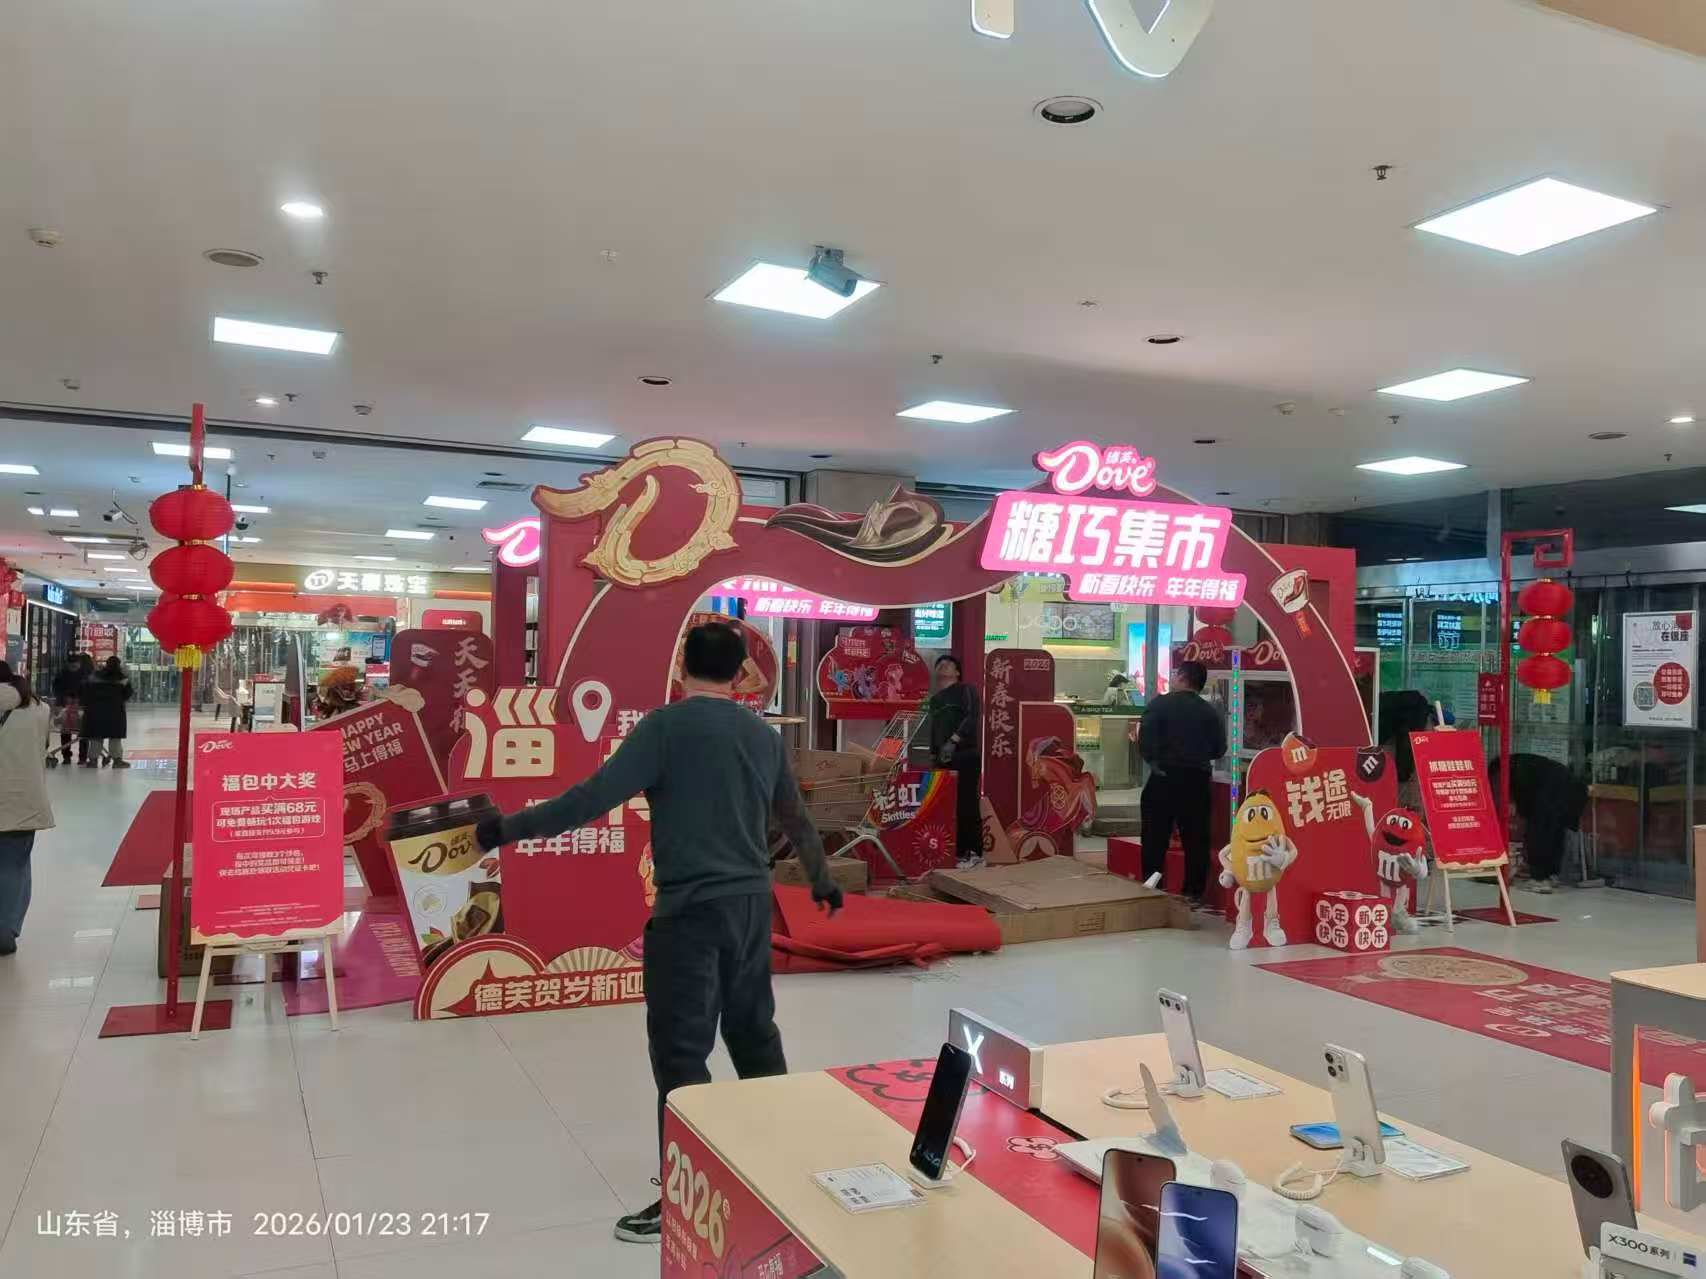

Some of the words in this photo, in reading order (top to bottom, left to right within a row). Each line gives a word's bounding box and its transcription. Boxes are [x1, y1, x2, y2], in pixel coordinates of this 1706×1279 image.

[1039, 445, 1154, 493] Dove
[999, 500, 1221, 571] 糖巧集市
[1078, 573, 1159, 598] 新春快乐
[1164, 576, 1240, 601] 年年得福
[990, 657, 1016, 758] 新春快乐
[366, 724, 404, 746] YEAR
[343, 739, 404, 773] 马上得福
[222, 772, 317, 792] 福包中大奖
[872, 783, 922, 812] 彩虹
[1286, 768, 1349, 828] 钱途
[515, 826, 625, 857] 年年得福
[1359, 908, 1386, 924] 新年
[1358, 930, 1386, 946] 快乐
[474, 973, 645, 1012] 德芙贺岁新迎
[666, 1141, 725, 1259] 2026
